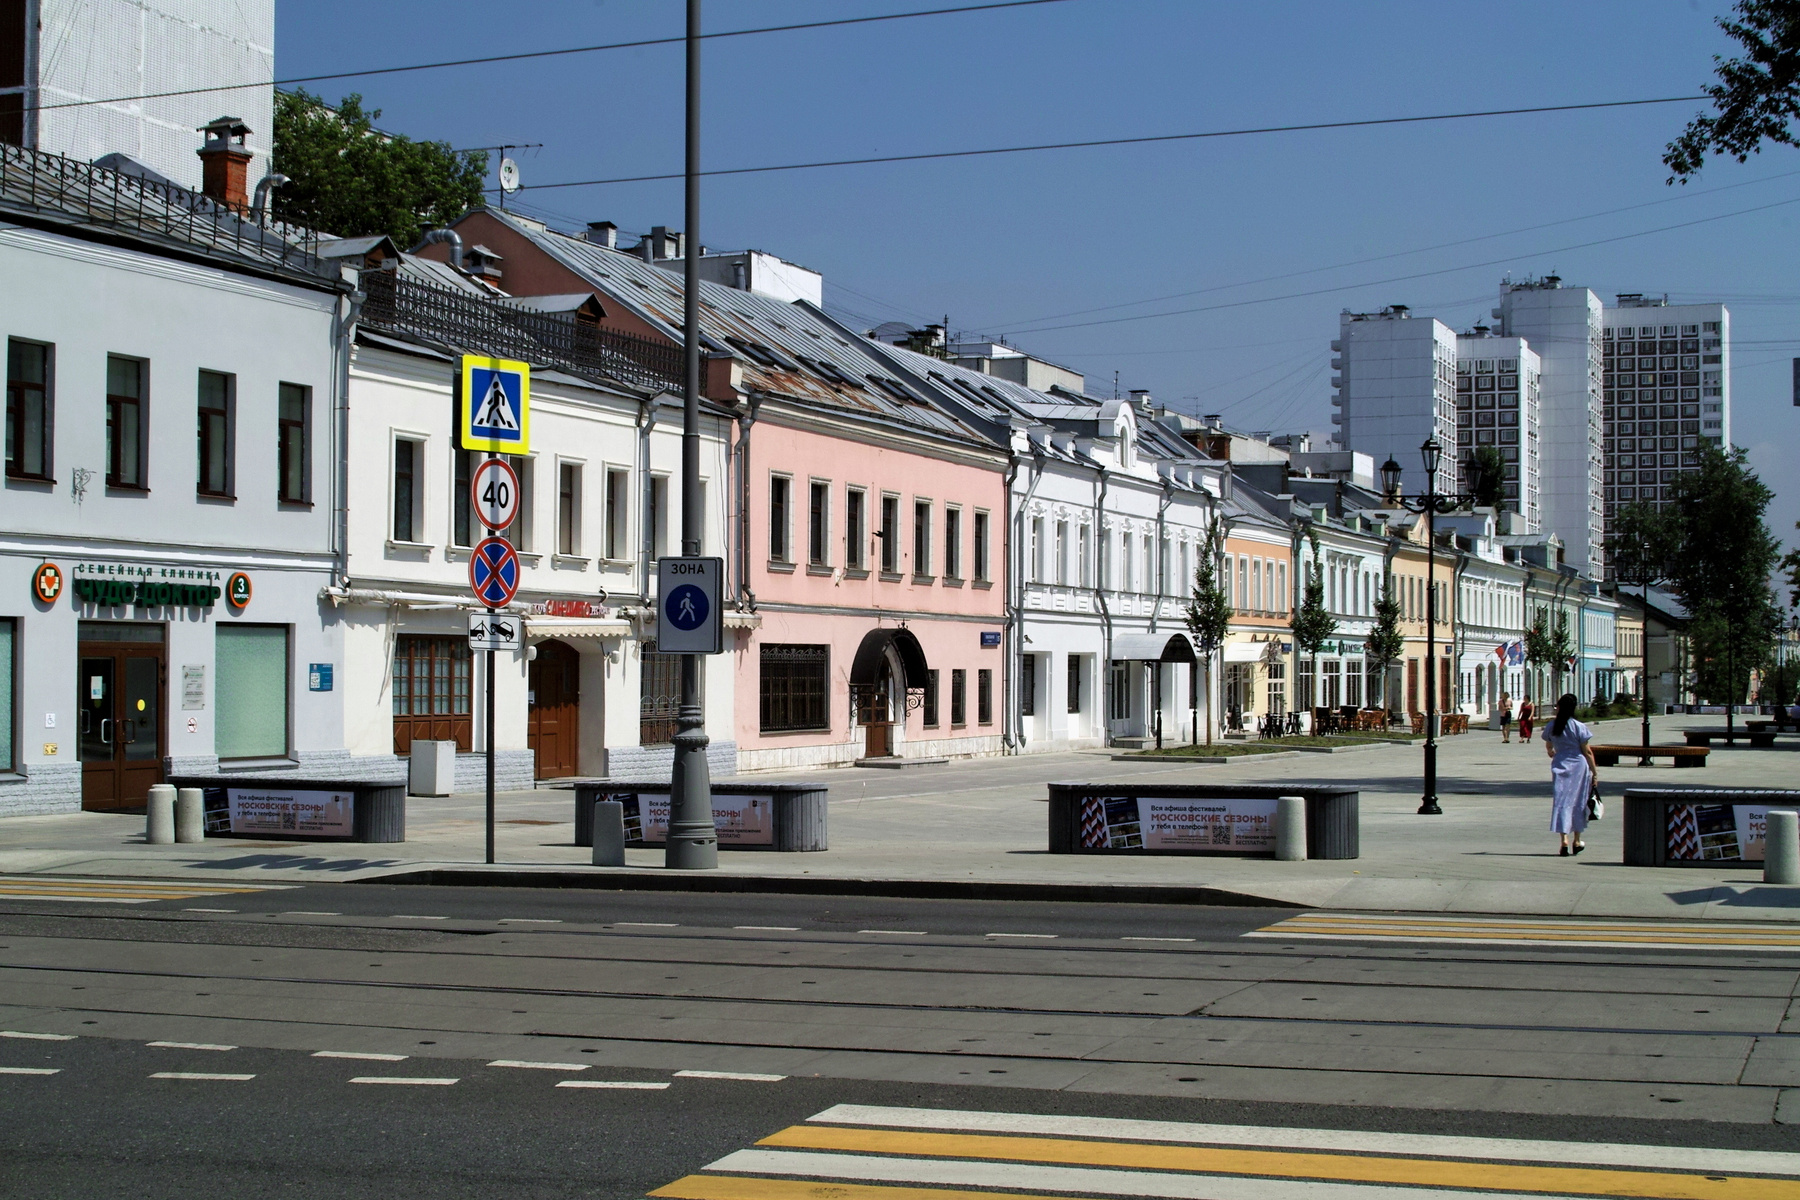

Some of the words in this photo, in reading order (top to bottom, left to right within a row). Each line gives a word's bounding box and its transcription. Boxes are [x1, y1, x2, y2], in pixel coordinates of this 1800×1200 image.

[482, 480, 509, 509] 40
[79, 563, 153, 577] СЕМЕЙНАЯ
[160, 568, 221, 581] КЛИНИКА
[670, 563, 705, 575] ЗОНА
[237, 577, 245, 593] 3
[77, 579, 136, 607] ЧУДО
[140, 581, 222, 608] ДОКТОР
[237, 802, 290, 811] МОСКОВСКИЕ
[291, 803, 324, 811] СЕЗОНЫ
[1164, 805, 1187, 813] афиша
[1188, 805, 1227, 813] фестивалей
[712, 809, 741, 818] ЕЗОНЫ
[1151, 813, 1221, 823] МОСКОВСКИЕ
[1223, 814, 1268, 824] СЕЗОНЫ
